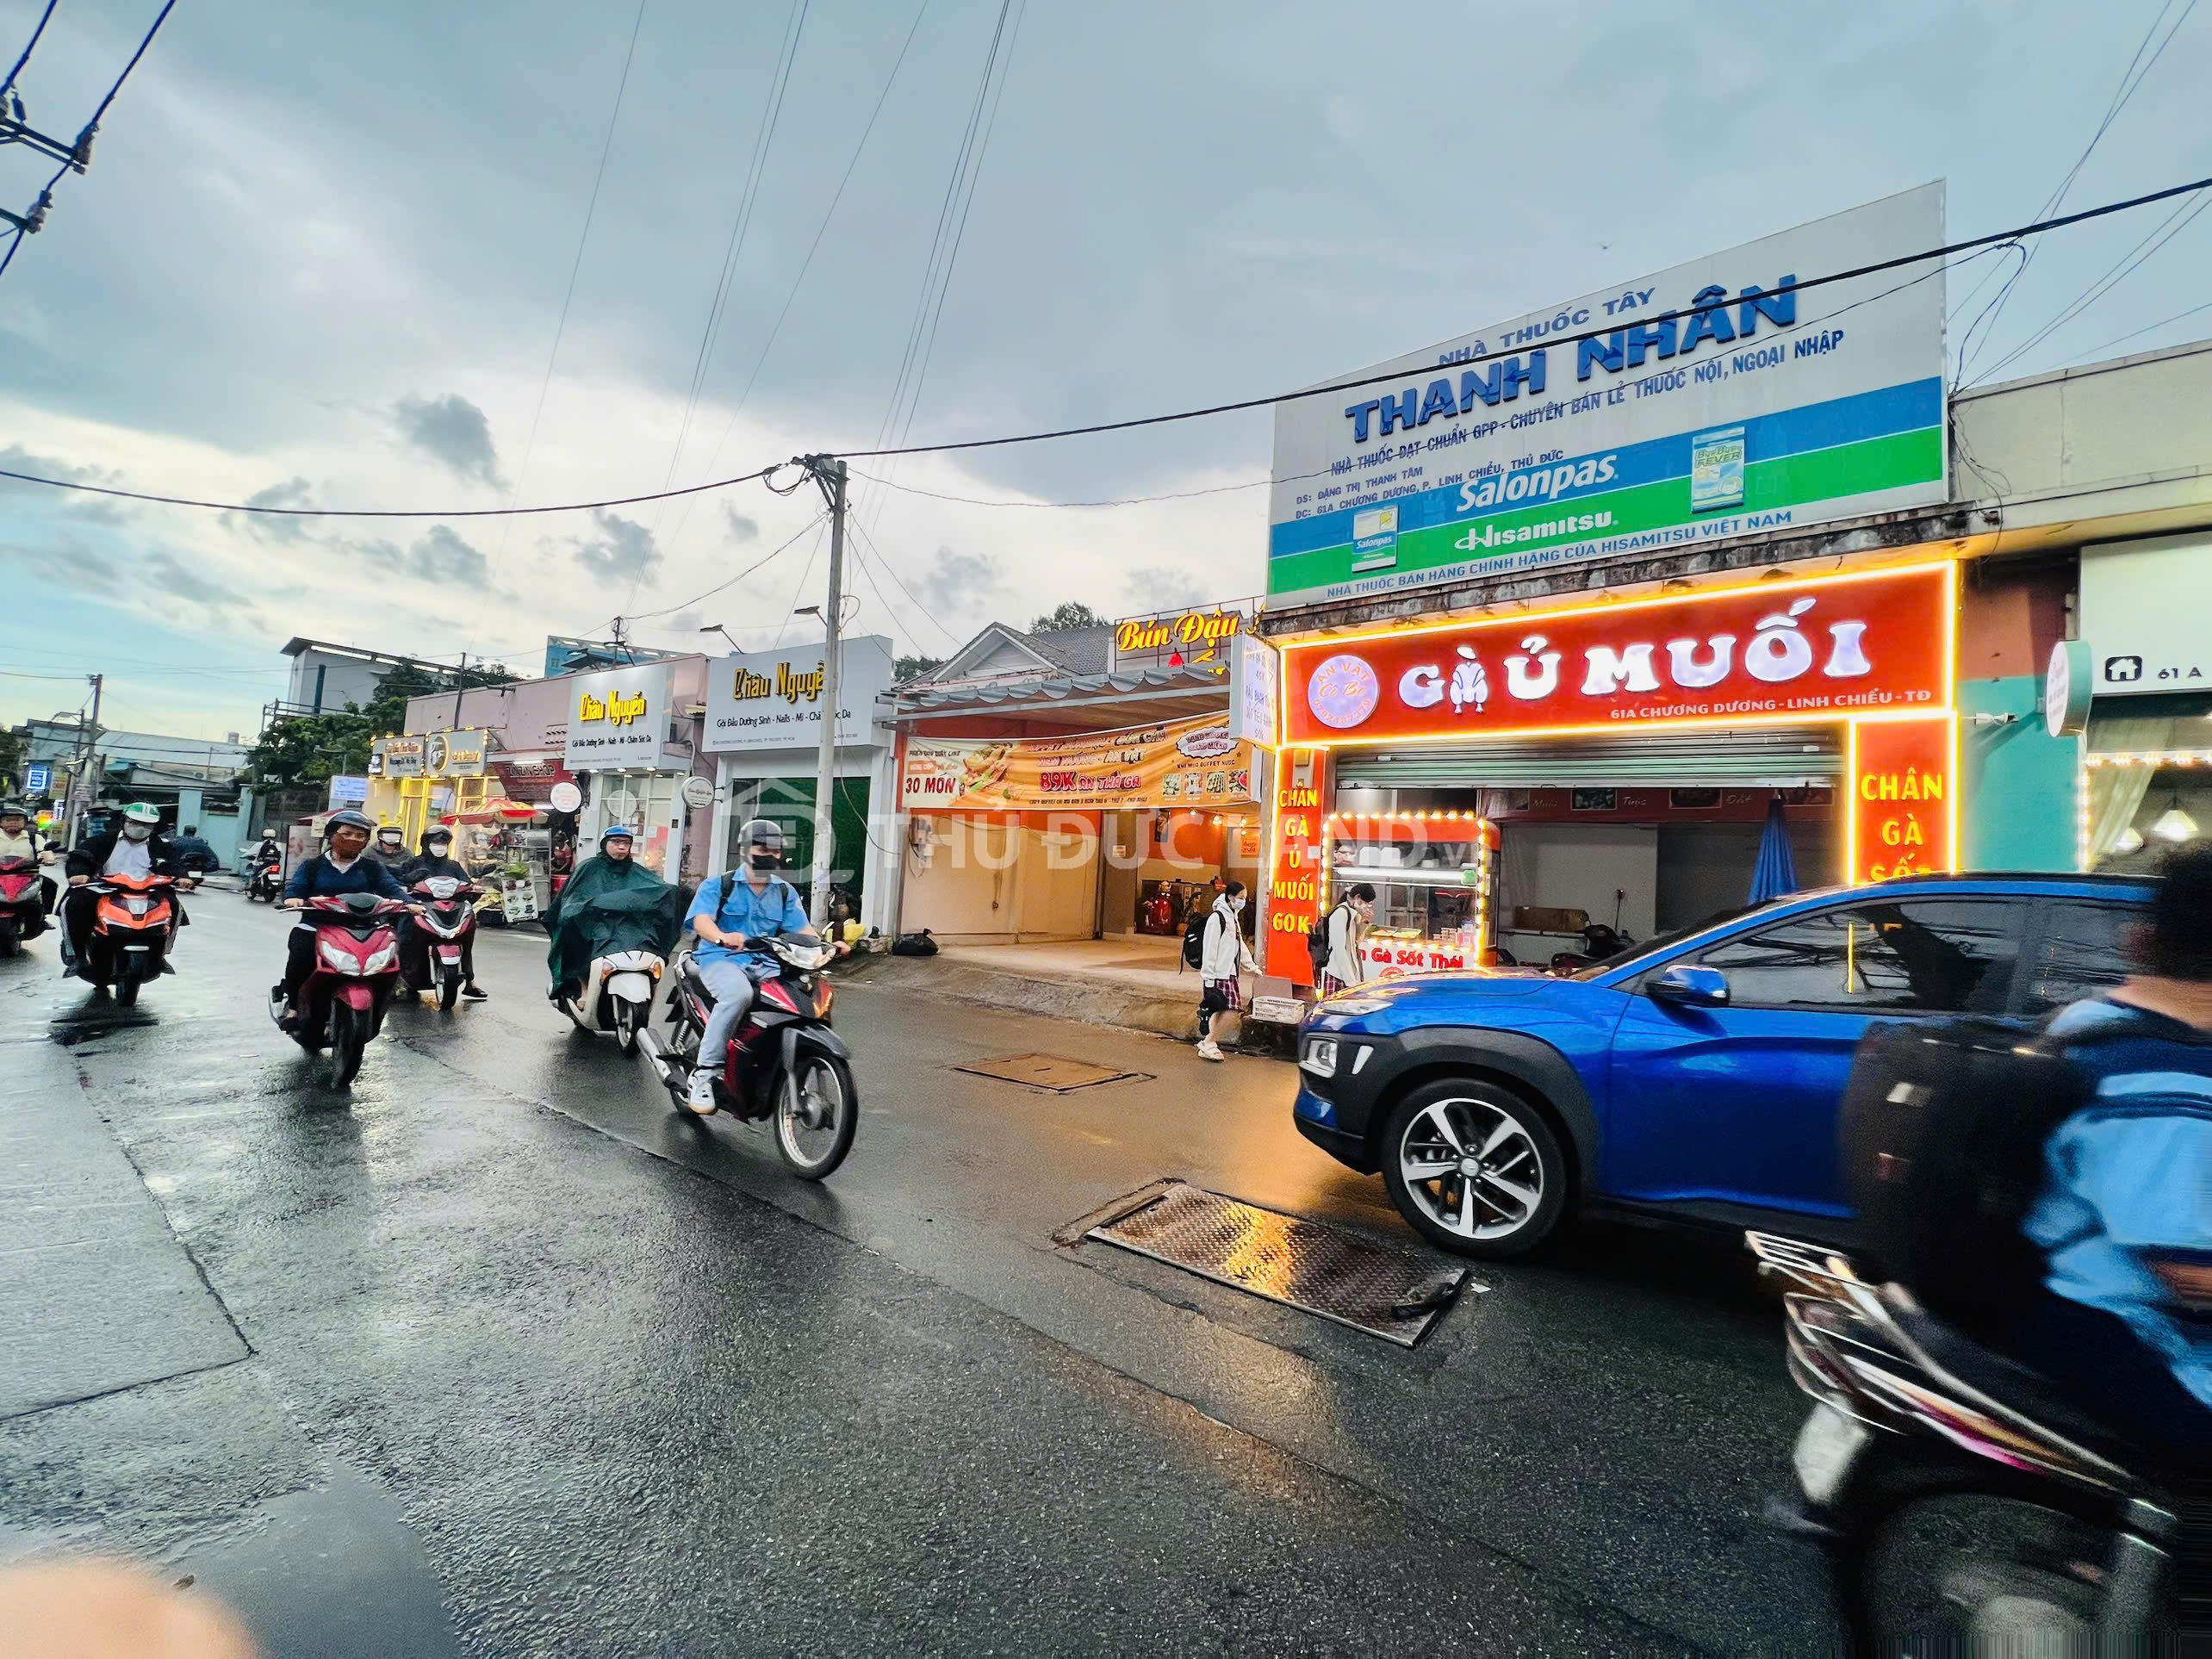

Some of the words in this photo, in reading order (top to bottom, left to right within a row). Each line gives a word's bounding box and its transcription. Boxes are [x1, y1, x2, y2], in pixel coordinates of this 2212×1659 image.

[1439, 340, 1488, 365] NHÀ
[1500, 307, 1590, 348] THUỐC
[1602, 288, 1656, 315] TÂY
[1345, 348, 1547, 443] THANH
[1577, 274, 1796, 382] NHÂN
[1331, 457, 1351, 476] NHÀ
[1358, 443, 1394, 463] THUỐC
[1427, 424, 1467, 451] CHUẨN
[1473, 420, 1499, 439] GPP
[1510, 401, 1564, 430] CHUYÊN
[1571, 390, 1600, 415] BÁN
[1607, 382, 1625, 407] LẺ
[1634, 366, 1686, 399] THUỐC
[1733, 344, 1785, 374] NGOẠI
[1794, 329, 1844, 359] NHẬP
[1695, 451, 1742, 469] FEVER
[1317, 503, 1333, 514] 61A
[1339, 493, 1378, 509] CHƯƠNG
[1438, 473, 1463, 487] LINH
[1511, 453, 1534, 470] THỦ
[1539, 449, 1564, 463] ĐỨC
[1365, 473, 1397, 488] THANH
[1401, 466, 1422, 479] TÂM
[1456, 454, 1617, 513] Salonpas
[1356, 536, 1393, 550] Salonpas
[1454, 510, 1612, 551] Hisamitsu
[1327, 584, 1351, 598] NHÀ
[1398, 572, 1425, 586] BÁN
[1428, 565, 1466, 581] HÀNG
[1469, 556, 1513, 575] CHÍNH
[1519, 550, 1560, 567] HÃNG
[1564, 543, 1596, 559] CỦA
[1601, 526, 1696, 553] HISAMITSU
[1701, 519, 1741, 537] VIỆT
[1748, 511, 1793, 530] NAM
[1116, 619, 1173, 651] Bún
[1173, 609, 1243, 648] Đậu
[1502, 635, 1563, 700] Ủ
[1580, 597, 1872, 696] MUỐI
[732, 668, 772, 700] Châu
[775, 660, 827, 704] Nguyễ
[2158, 668, 2178, 679] 61
[1639, 702, 1709, 718] CHƯƠNG
[1713, 698, 1777, 714] DƯƠNG
[1786, 695, 1830, 710] LINH
[1905, 689, 1931, 702] TĐ
[905, 777, 921, 794] 30
[1040, 771, 1076, 792] 89K
[1278, 780, 1318, 808] CHÂN
[1861, 766, 1943, 801] CHÂN
[1284, 814, 1310, 837] GÀ
[1881, 813, 1923, 846] GÀ
[1289, 843, 1302, 869] Ủ
[1273, 873, 1314, 901] MUỐI
[1371, 948, 1392, 963] Gà
[1396, 949, 1424, 966] Sốt
